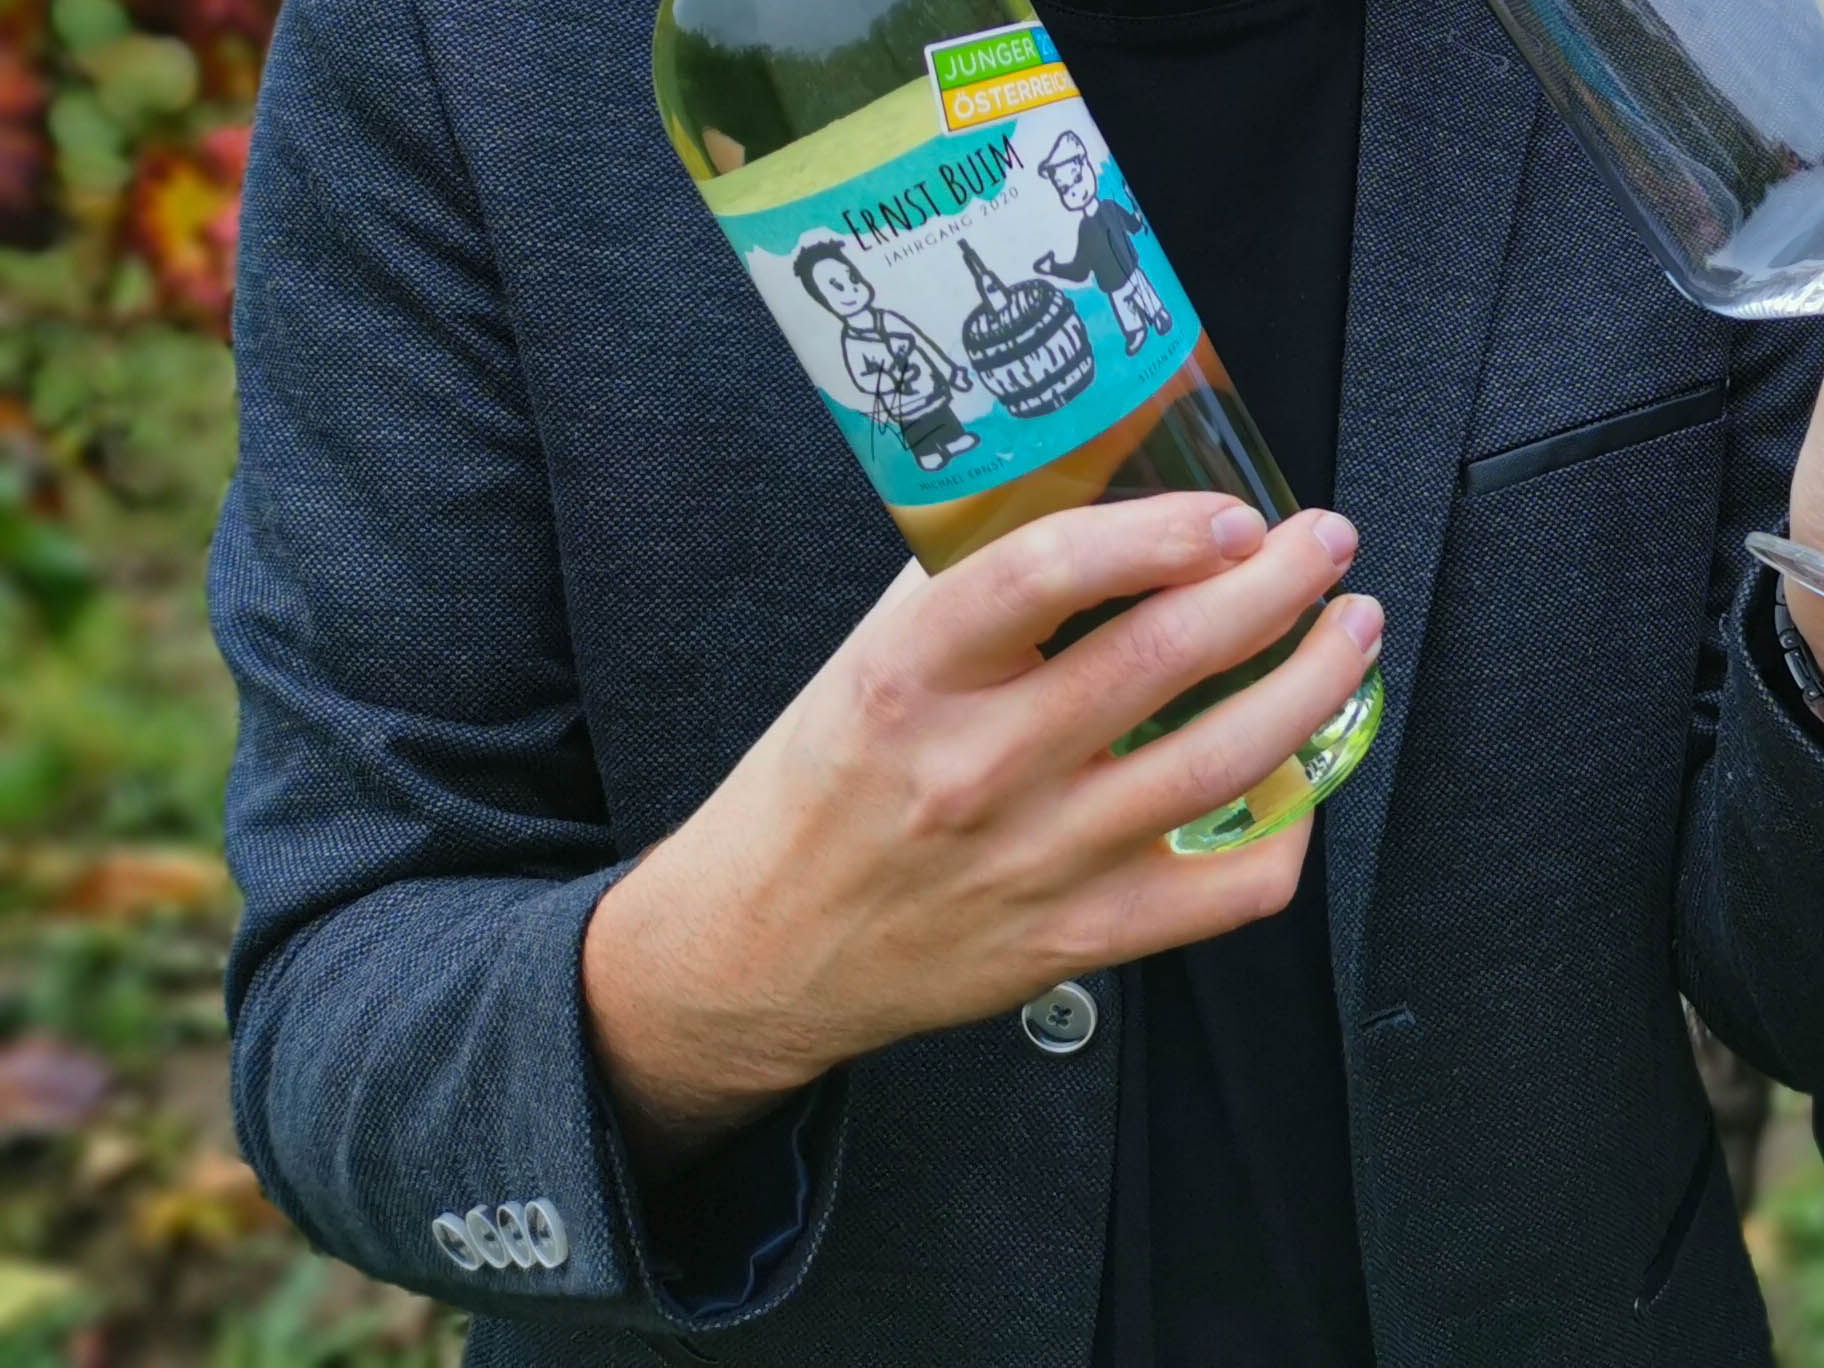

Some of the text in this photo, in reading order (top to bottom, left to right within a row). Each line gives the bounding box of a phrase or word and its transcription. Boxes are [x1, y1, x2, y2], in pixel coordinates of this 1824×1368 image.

[944, 36, 1036, 81] JUNGER
[842, 133, 1024, 251] ERNST BUIM
[884, 186, 1019, 268] JAHRGANG 2020
[919, 458, 1006, 492] MICHAEL ERNST
